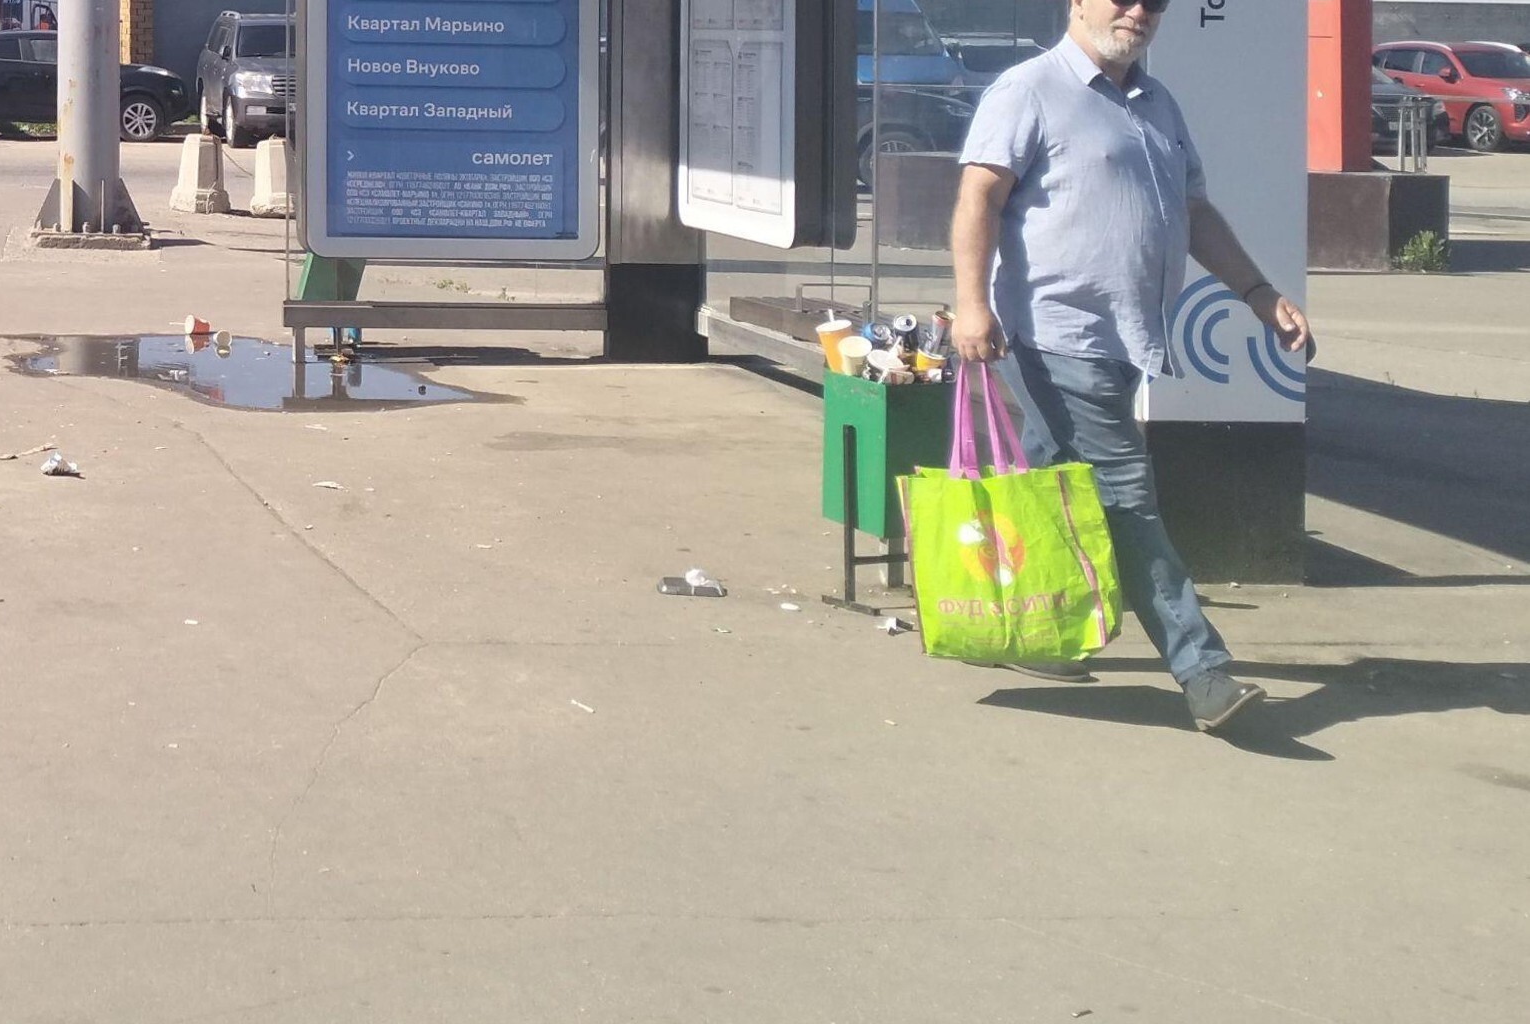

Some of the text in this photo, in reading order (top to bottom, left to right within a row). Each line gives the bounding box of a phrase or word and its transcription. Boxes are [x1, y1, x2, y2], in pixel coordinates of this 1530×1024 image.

[348, 16, 504, 35] Квартал Марьино
[348, 59, 479, 77] Новое Внуково
[348, 102, 512, 120] Квартал Западный
[473, 153, 553, 165] самолет
